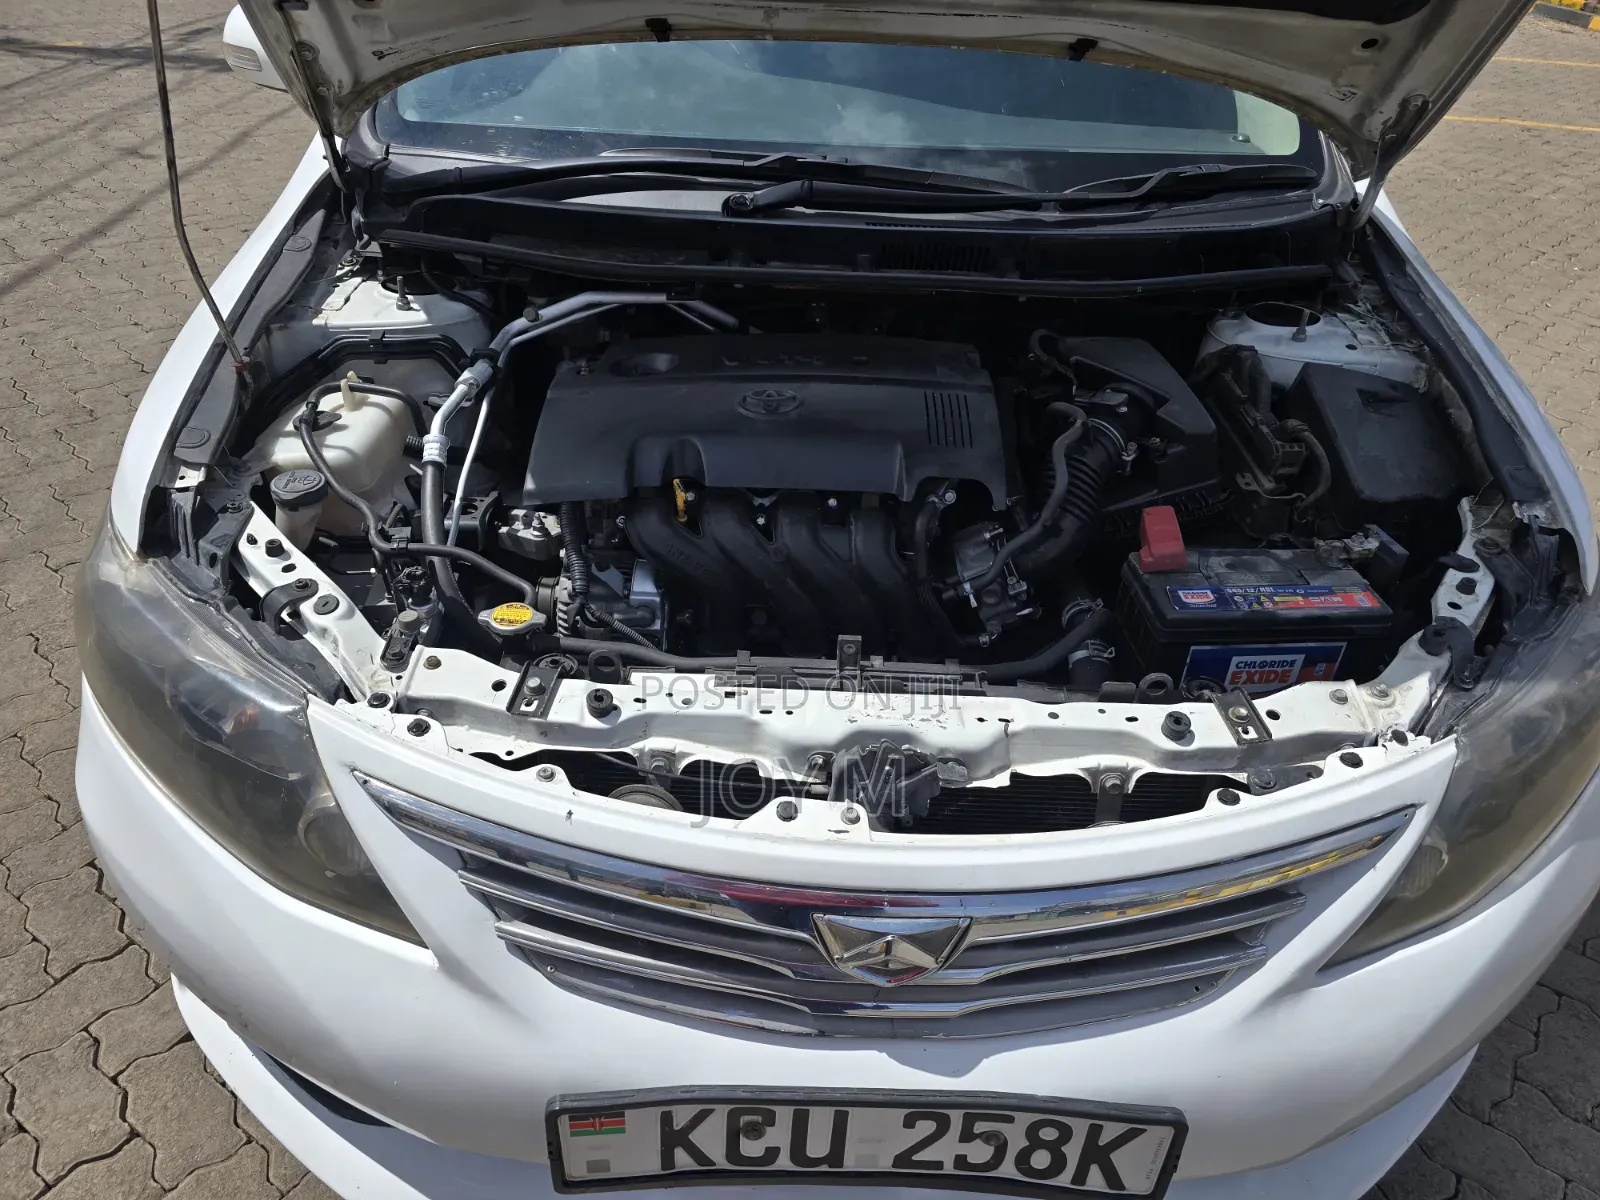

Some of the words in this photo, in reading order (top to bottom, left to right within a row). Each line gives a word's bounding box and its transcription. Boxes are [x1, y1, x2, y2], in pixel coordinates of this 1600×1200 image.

[1235, 659, 1297, 669] CHLORIDE
[1230, 669, 1293, 685] EXIDE
[659, 1108, 849, 1171] KCU
[891, 1110, 1148, 1192] 258K
